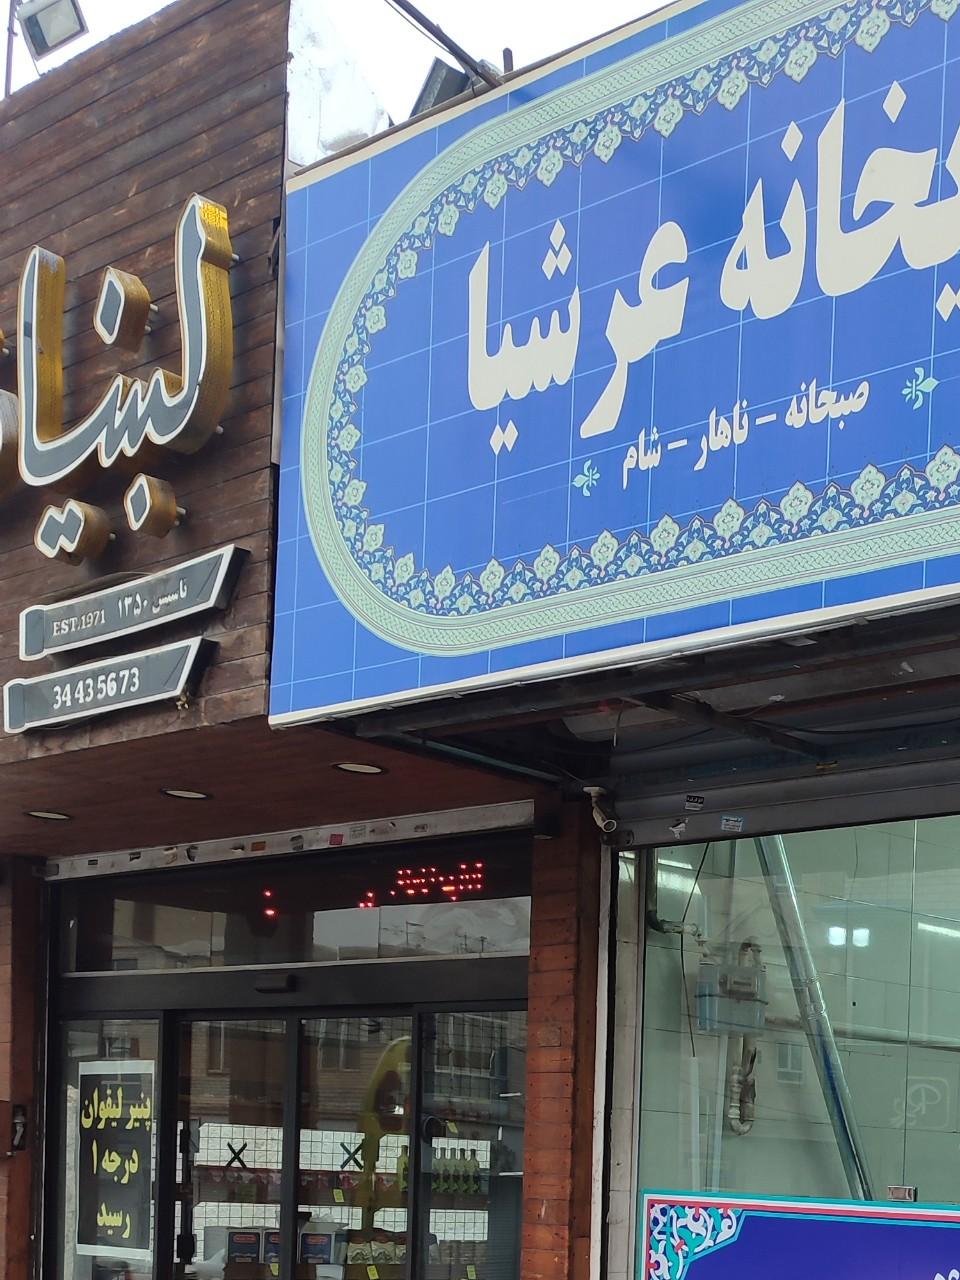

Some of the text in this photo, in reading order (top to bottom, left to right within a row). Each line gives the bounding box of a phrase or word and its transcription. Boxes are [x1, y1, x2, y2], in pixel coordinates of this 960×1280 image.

[467, 218, 690, 455] عرشیا
[0, 191, 232, 559] لبنیا
[785, 377, 870, 431] صبحانه
[693, 399, 749, 471] ناهار
[622, 426, 661, 490] شام
[117, 578, 188, 618] تاسیس ۱۳۵۰
[52, 609, 106, 637] EST.1971
[52, 666, 140, 710] 34435673
[81, 1087, 151, 1131] پنیر لیقوان
[101, 1149, 140, 1184] درجه
[97, 1202, 131, 1238] رسید
